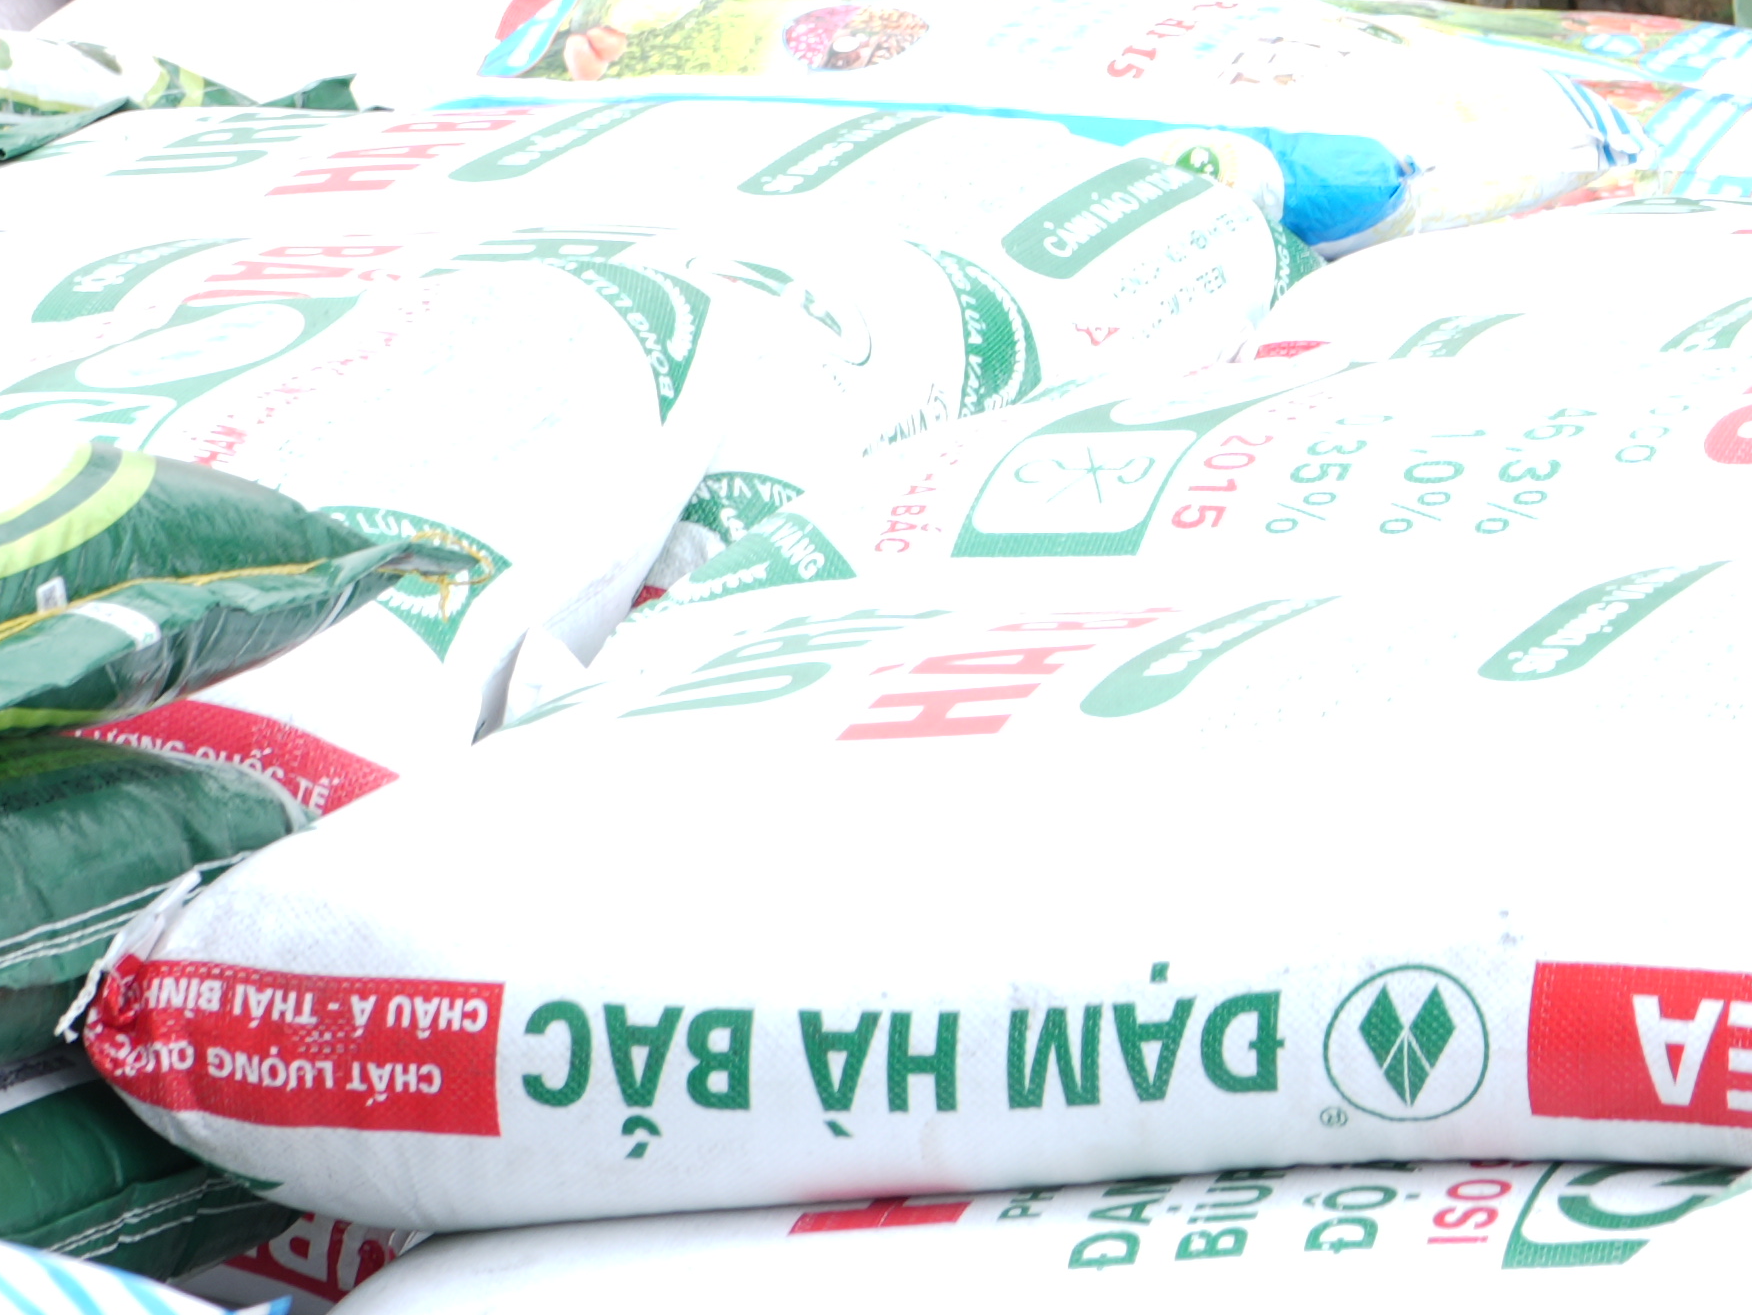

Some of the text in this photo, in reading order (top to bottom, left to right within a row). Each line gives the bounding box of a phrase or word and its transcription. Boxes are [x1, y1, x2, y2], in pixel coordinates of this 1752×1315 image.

[234, 983, 319, 1030] THÁI
[349, 993, 377, 1039] Á
[386, 993, 489, 1040] CHÂU
[206, 1046, 336, 1092] LƯỢNG
[346, 1061, 442, 1108] CHẤT
[519, 961, 1285, 1165] ĐẠM HÀ BẮC
